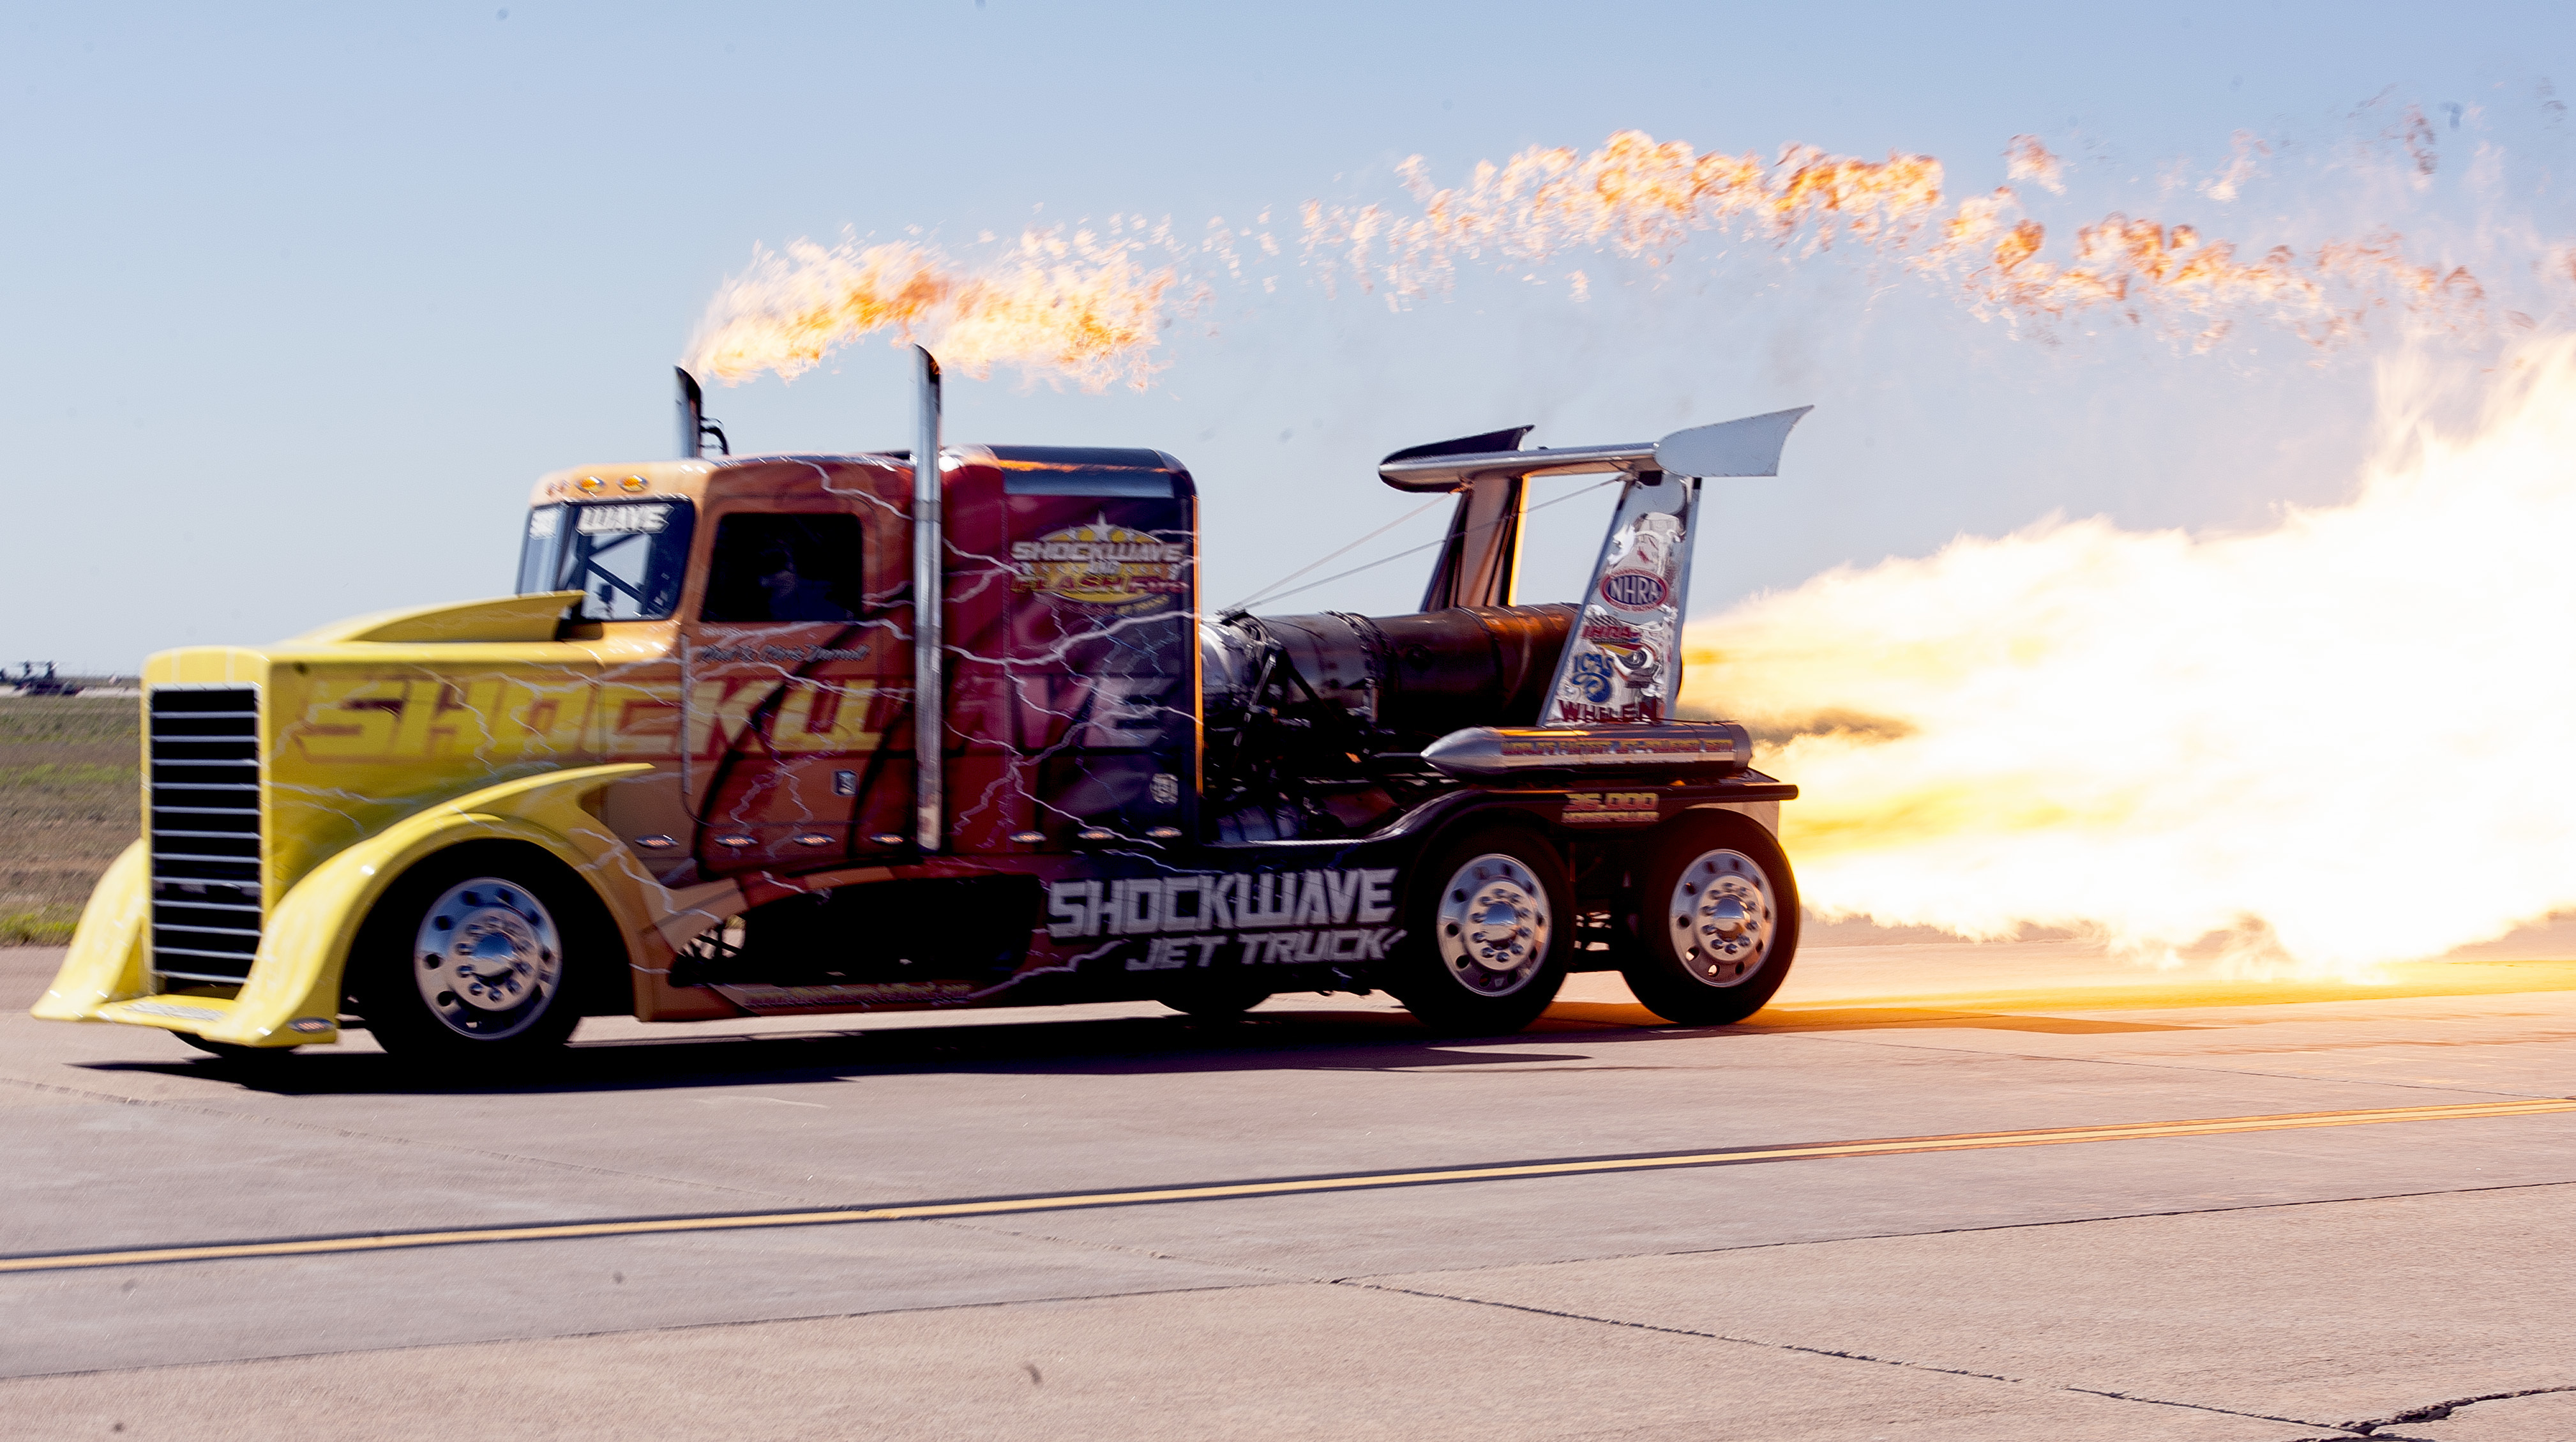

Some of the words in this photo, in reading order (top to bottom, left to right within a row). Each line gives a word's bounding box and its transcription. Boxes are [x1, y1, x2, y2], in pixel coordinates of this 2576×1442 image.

[1010, 541, 1187, 561] SHOCKWAVE
[1609, 575, 1662, 604] NHRA
[1556, 699, 1657, 725] WHELEN
[1046, 868, 1398, 939] SHOCKWAVE
[1125, 935, 1228, 971] JET
[1237, 927, 1390, 964] TRUCK
